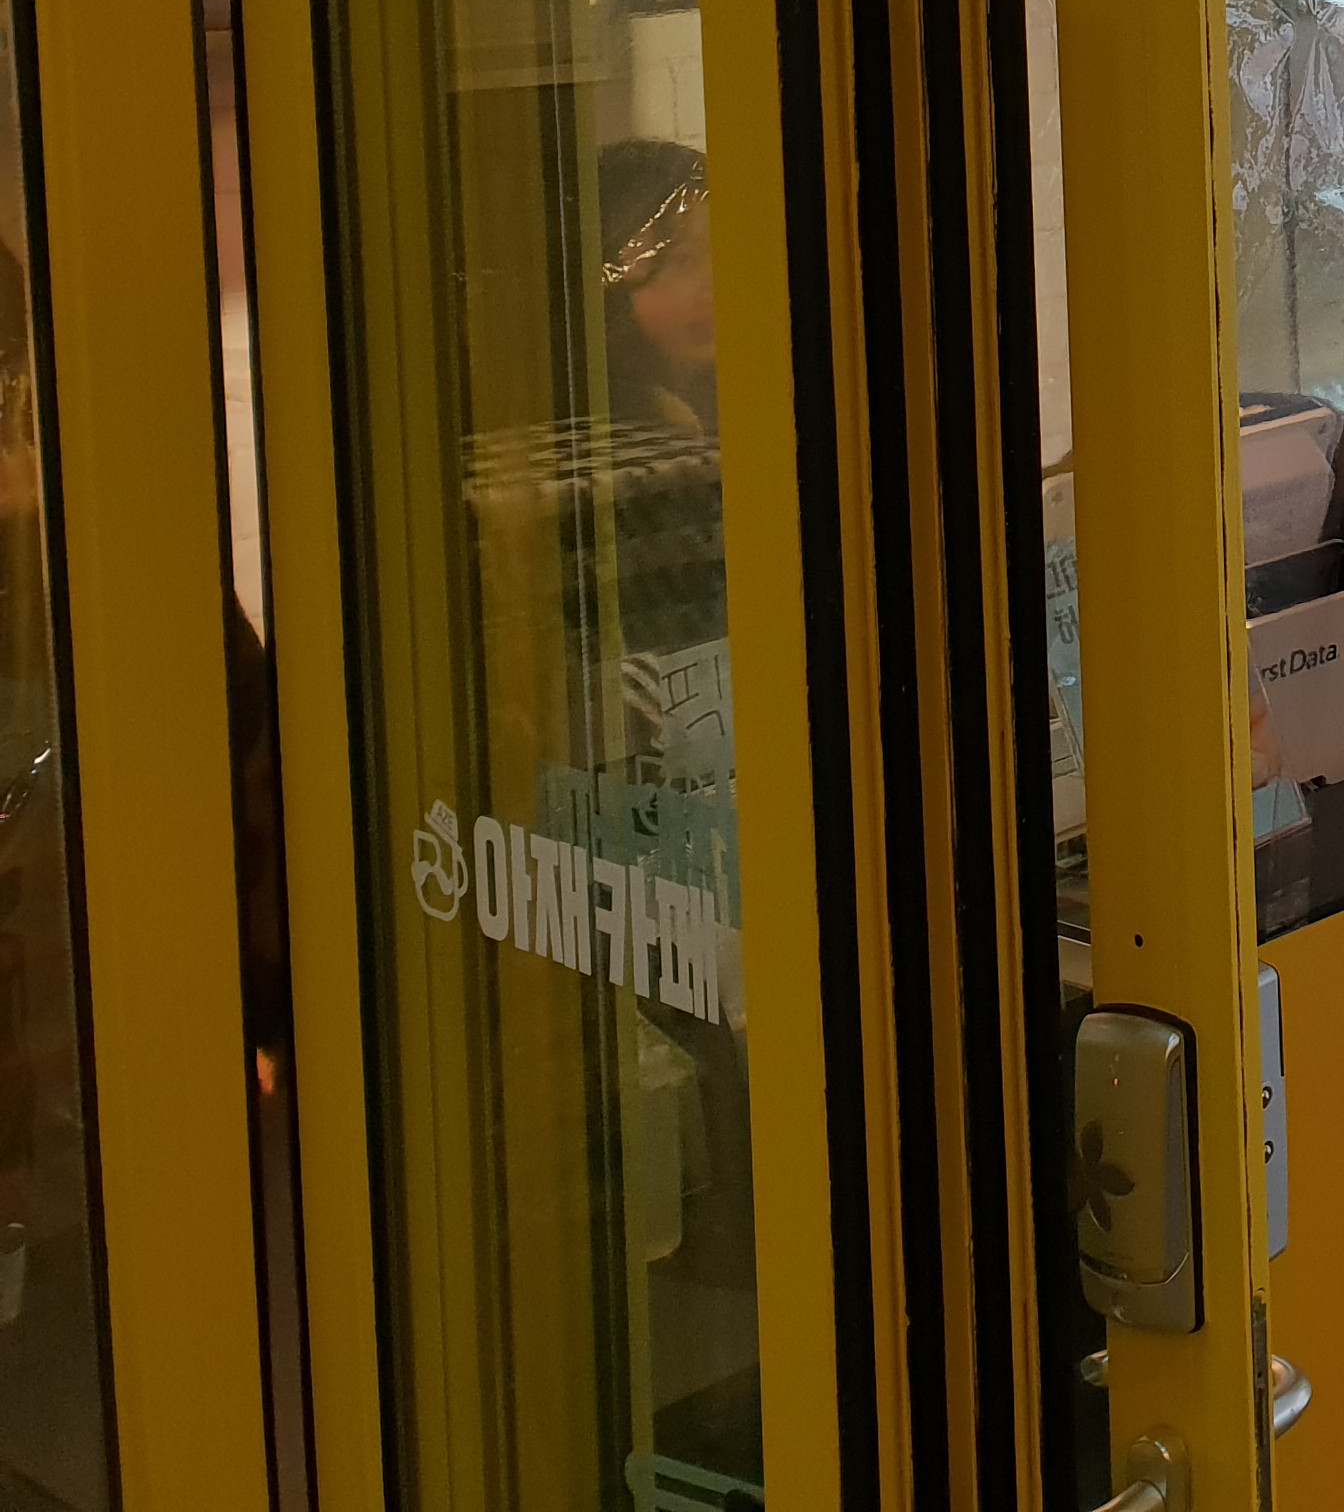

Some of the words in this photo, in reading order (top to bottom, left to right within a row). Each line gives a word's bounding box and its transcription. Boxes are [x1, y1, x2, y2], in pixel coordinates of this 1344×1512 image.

[1257, 657, 1287, 682] rst
[1288, 639, 1340, 672] Data
[472, 814, 723, 1027] 아재카페
